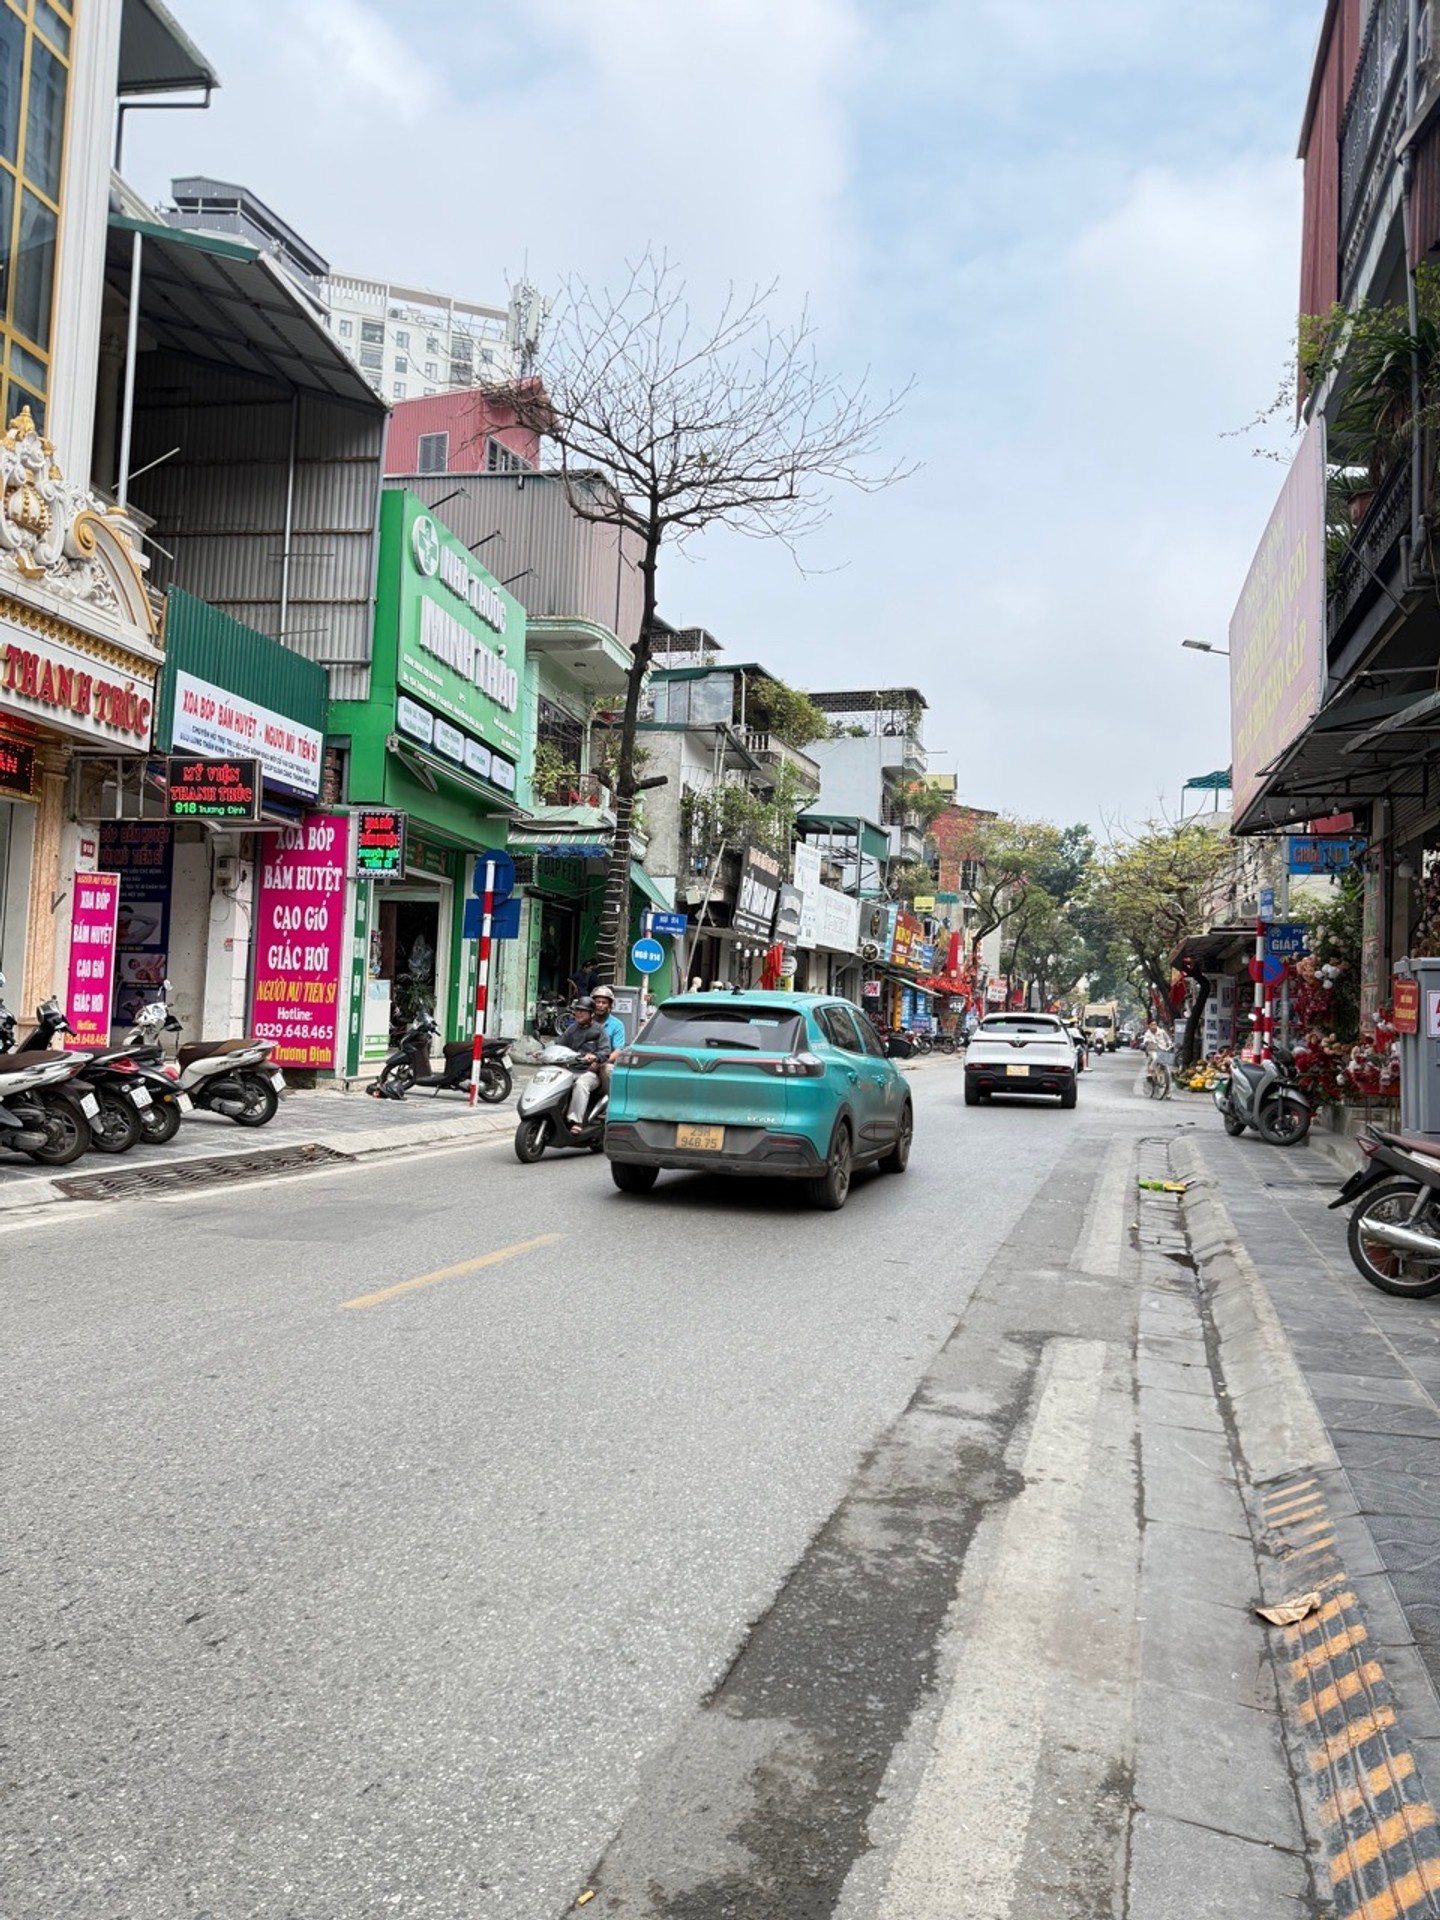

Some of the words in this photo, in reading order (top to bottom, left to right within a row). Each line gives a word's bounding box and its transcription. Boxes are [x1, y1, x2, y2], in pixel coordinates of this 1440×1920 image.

[439, 545, 470, 602] NHÀ
[469, 573, 506, 634] THUỐC
[420, 595, 476, 682] MINH
[476, 642, 518, 713] THẢO
[5, 643, 93, 716] THANH
[97, 680, 151, 737] TRÚC
[182, 688, 198, 716] XOA
[199, 692, 216, 722] BÓP
[217, 698, 234, 730] BẤM
[234, 711, 258, 743] HUYỆT
[263, 722, 286, 750] NGƯỜI
[286, 728, 296, 754] MÙ
[298, 732, 311, 761] TIẾN
[183, 763, 203, 782] MỸ
[207, 763, 240, 785] VIỆN
[170, 786, 216, 801] THANH
[219, 783, 252, 802] TRÚC
[175, 802, 197, 813] 918
[276, 827, 304, 850] XOA
[307, 820, 335, 852] BÓP
[263, 854, 294, 890] BẤM
[296, 859, 343, 898] HUYỆT
[80, 890, 94, 909] XOA
[95, 888, 110, 910] BÓP
[73, 919, 90, 943] BẤM
[90, 923, 113, 948] HUYỆT
[273, 905, 301, 937] CẠO
[267, 938, 302, 971] GIÁC
[303, 942, 329, 971] HƠI
[1271, 937, 1299, 951] GIÁP
[76, 959, 91, 981] CẠO
[256, 975, 287, 1001] NGƯỜI
[287, 976, 301, 1002] MÙ
[304, 974, 325, 1003] TIẾN
[91, 992, 105, 1013] HƠI
[277, 1007, 313, 1021] Hotline:
[255, 1023, 334, 1039] 0329.648.465
[275, 1044, 307, 1063] Trương
[309, 1045, 331, 1066] Định
